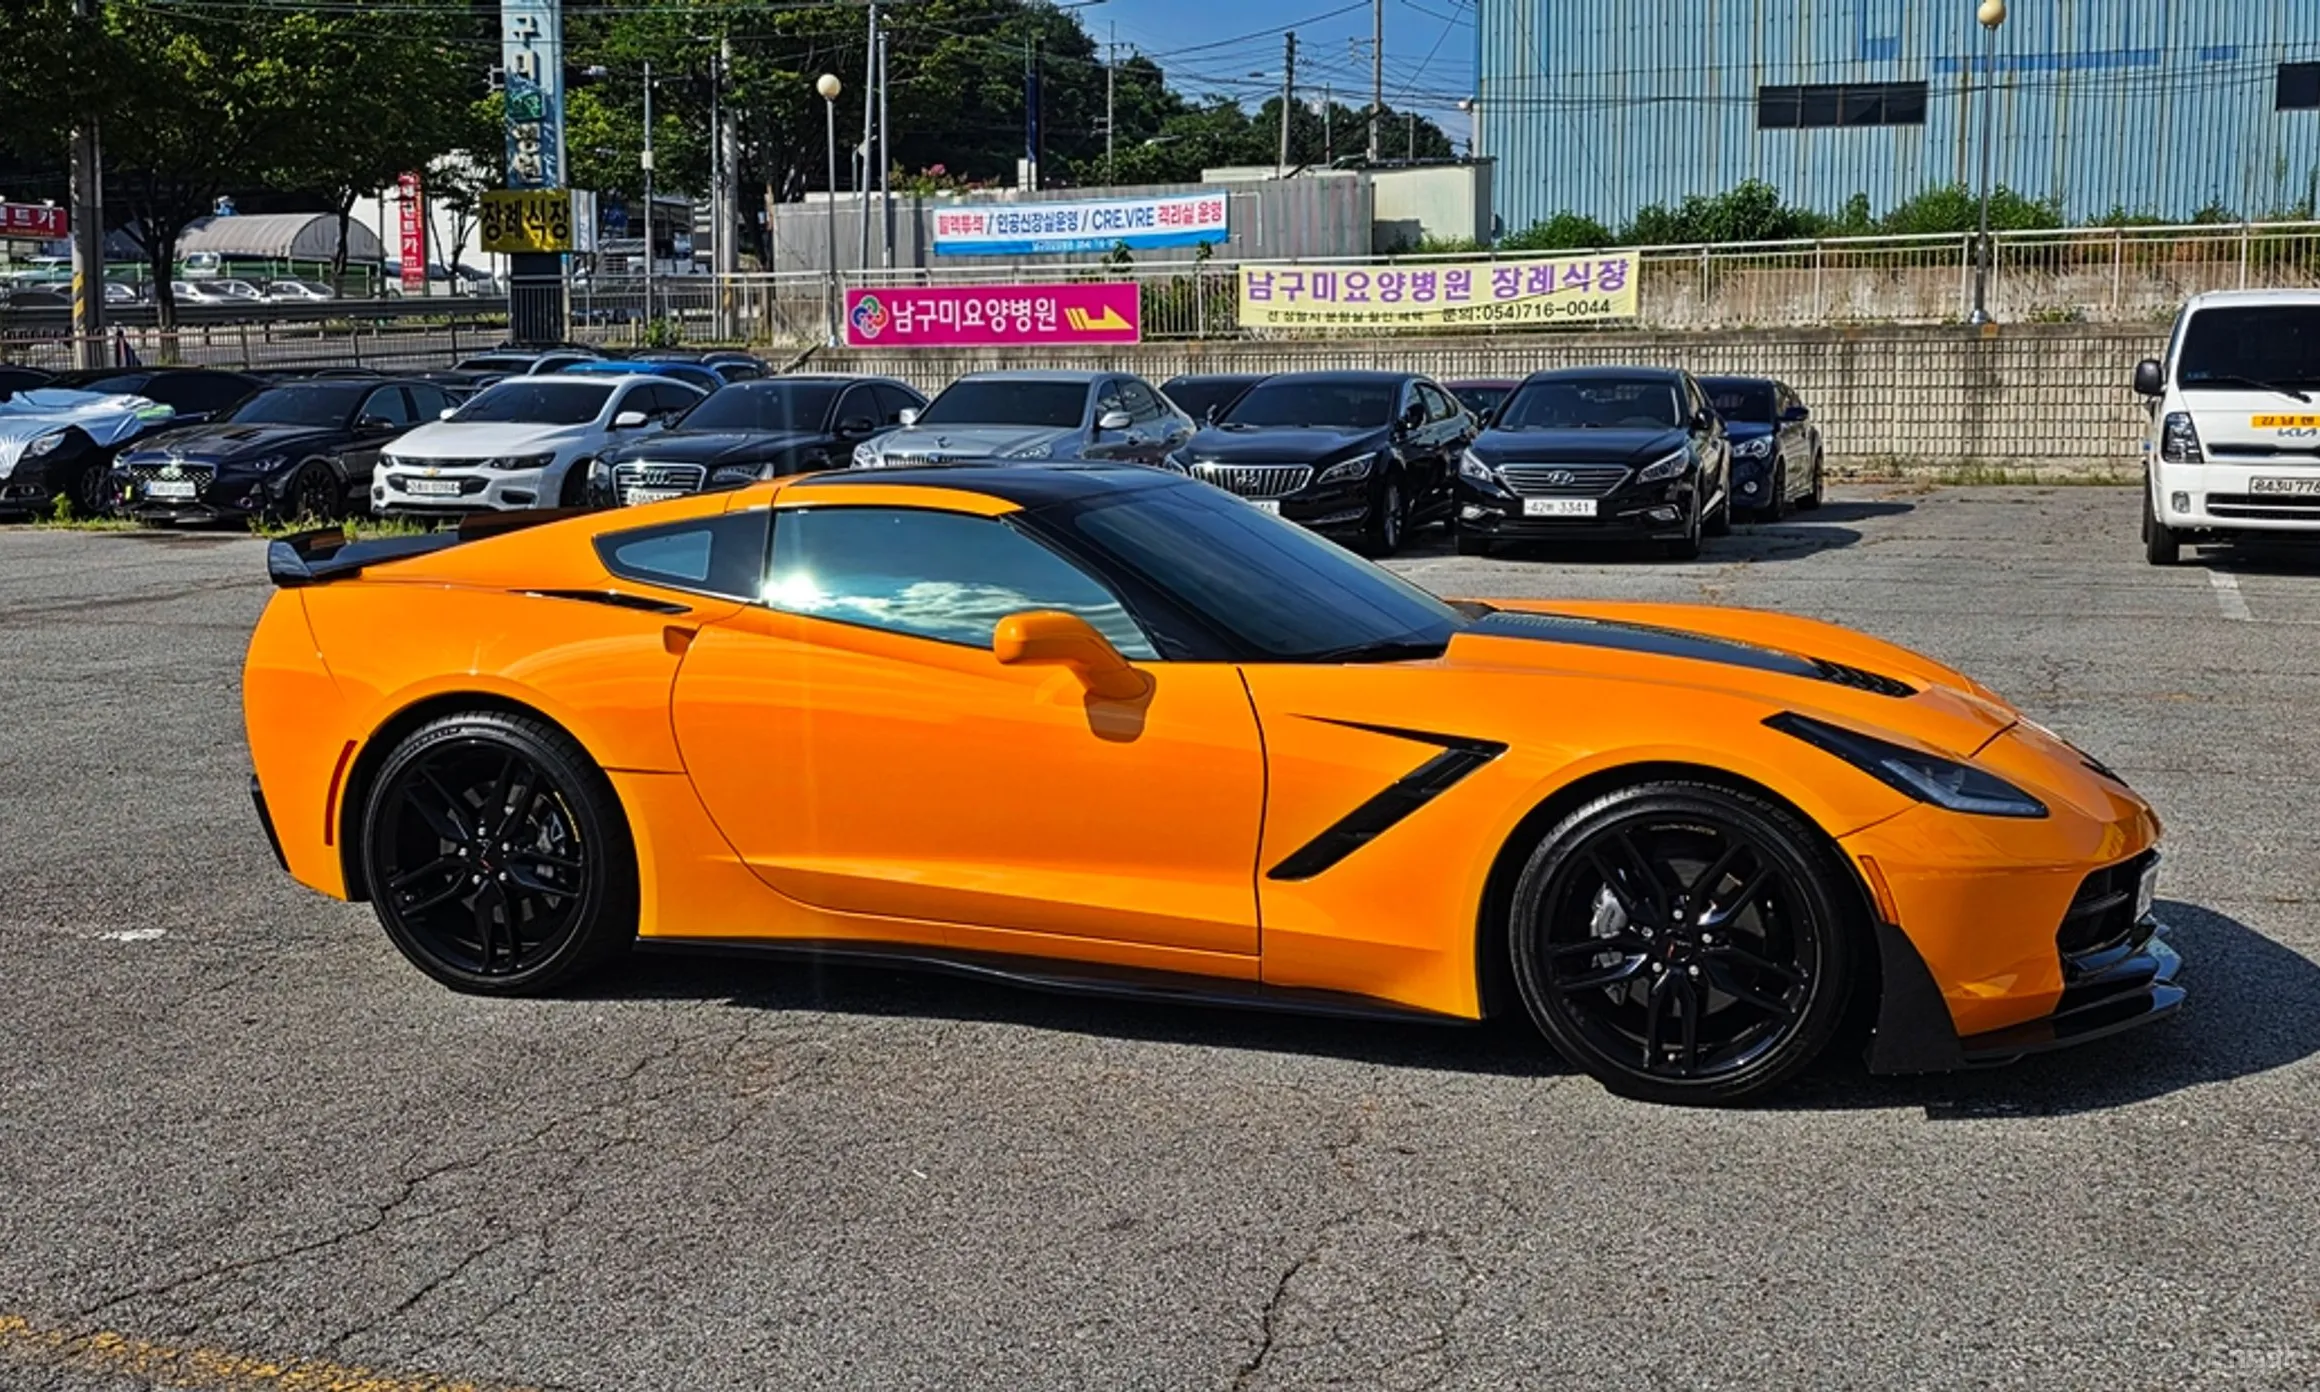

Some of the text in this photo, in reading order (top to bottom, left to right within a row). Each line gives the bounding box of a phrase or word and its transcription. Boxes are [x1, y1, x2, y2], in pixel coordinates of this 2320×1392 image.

[0, 206, 56, 230] 트카
[482, 198, 570, 242] 장례식장
[997, 210, 1079, 234] 인공신장실운영
[1246, 258, 1630, 303] 남구미요양병원 장례식장
[891, 297, 1058, 333] 남구미요양병원
